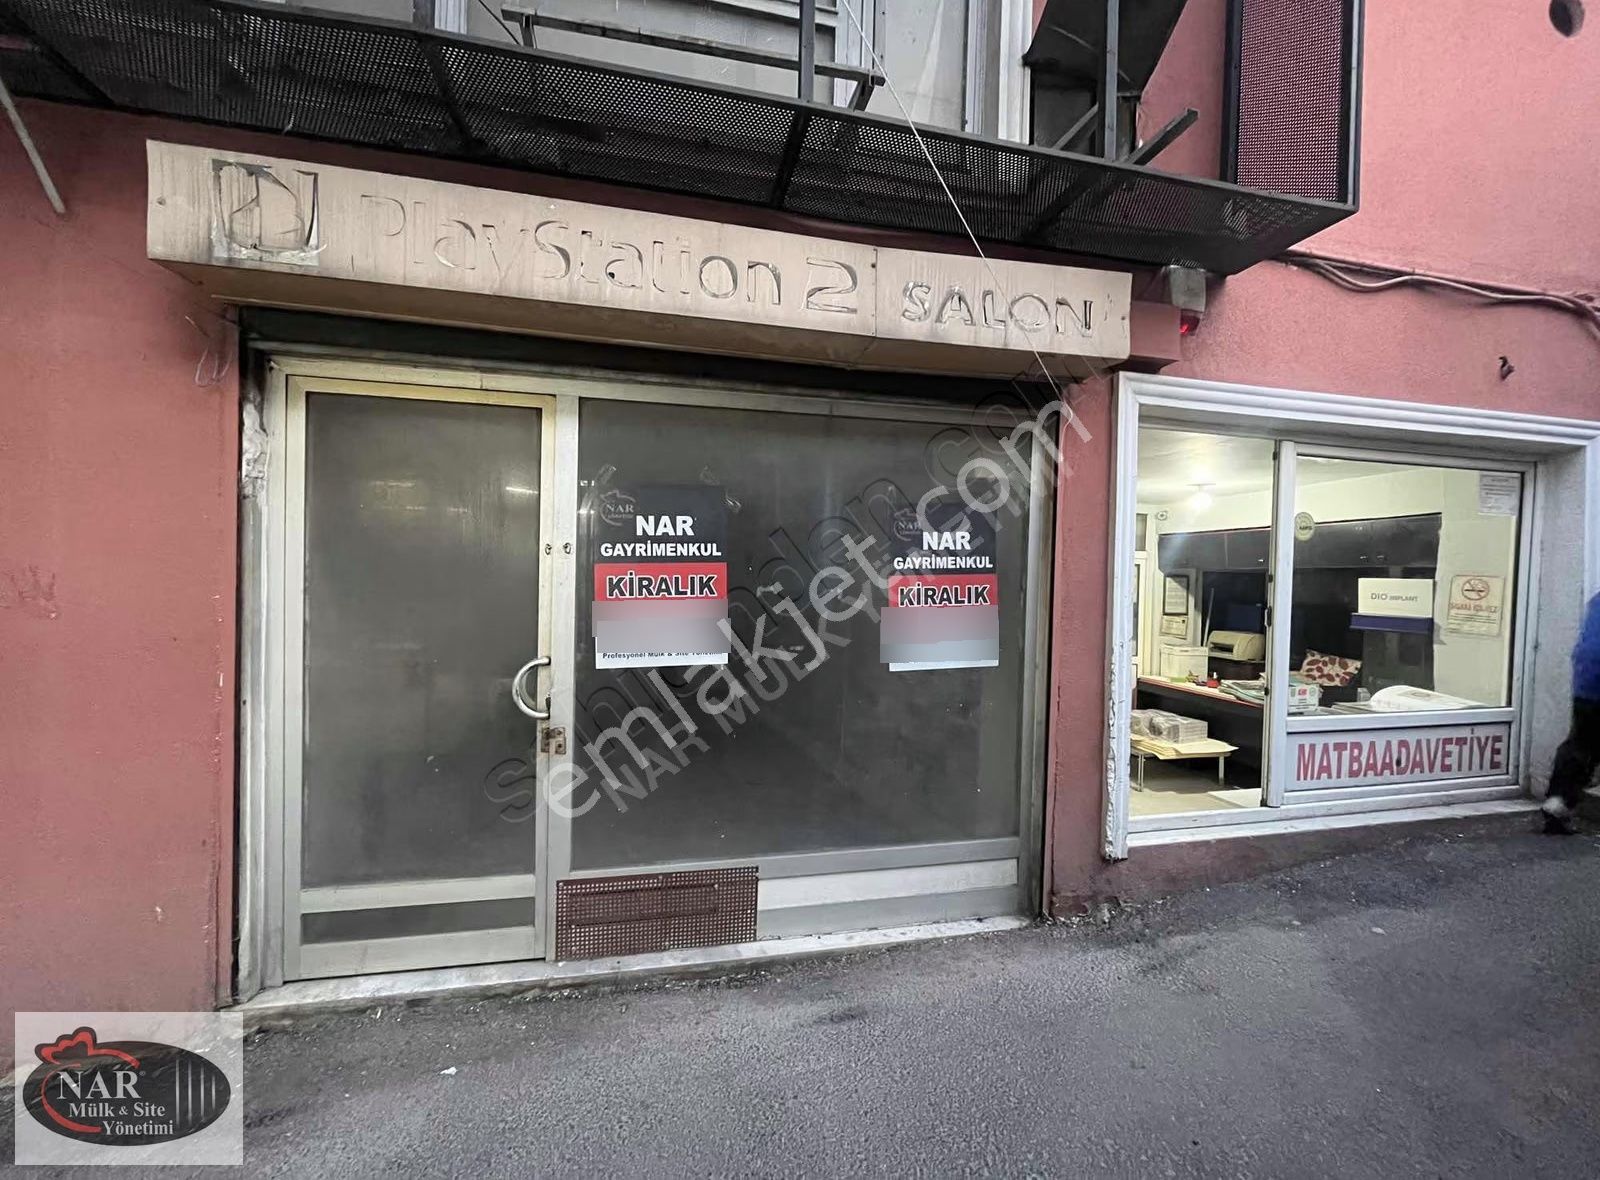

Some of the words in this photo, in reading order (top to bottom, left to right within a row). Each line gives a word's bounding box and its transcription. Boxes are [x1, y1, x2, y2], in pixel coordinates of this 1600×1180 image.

[806, 256, 858, 314] 2
[635, 515, 695, 536] NAR
[600, 542, 722, 557] GAYRİMENKUL
[922, 531, 971, 551] NAR
[893, 554, 993, 570] GAYRİMENKUL
[606, 570, 718, 599] KİRALIK
[898, 582, 991, 607] KİRALIK
